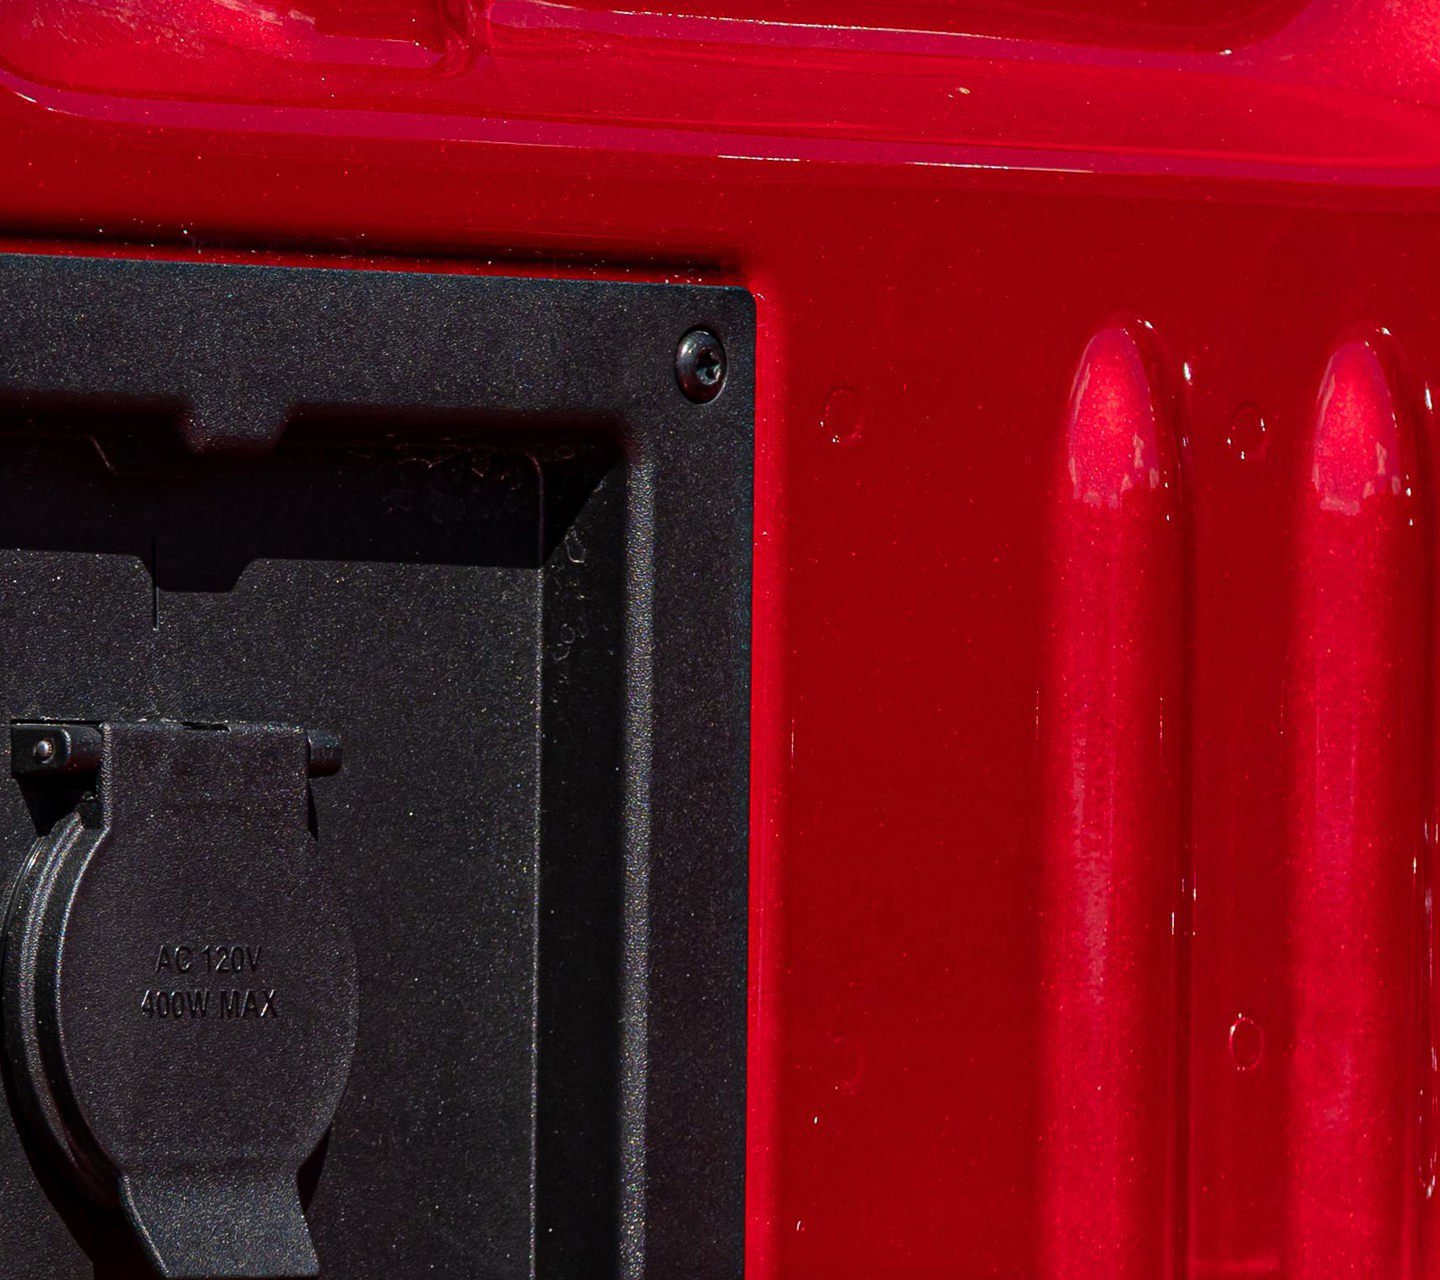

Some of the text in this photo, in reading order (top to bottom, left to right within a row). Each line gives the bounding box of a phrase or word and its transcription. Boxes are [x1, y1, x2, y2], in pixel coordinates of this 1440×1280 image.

[154, 944, 262, 974] AC 120V
[140, 987, 278, 1019] 400W MAX
